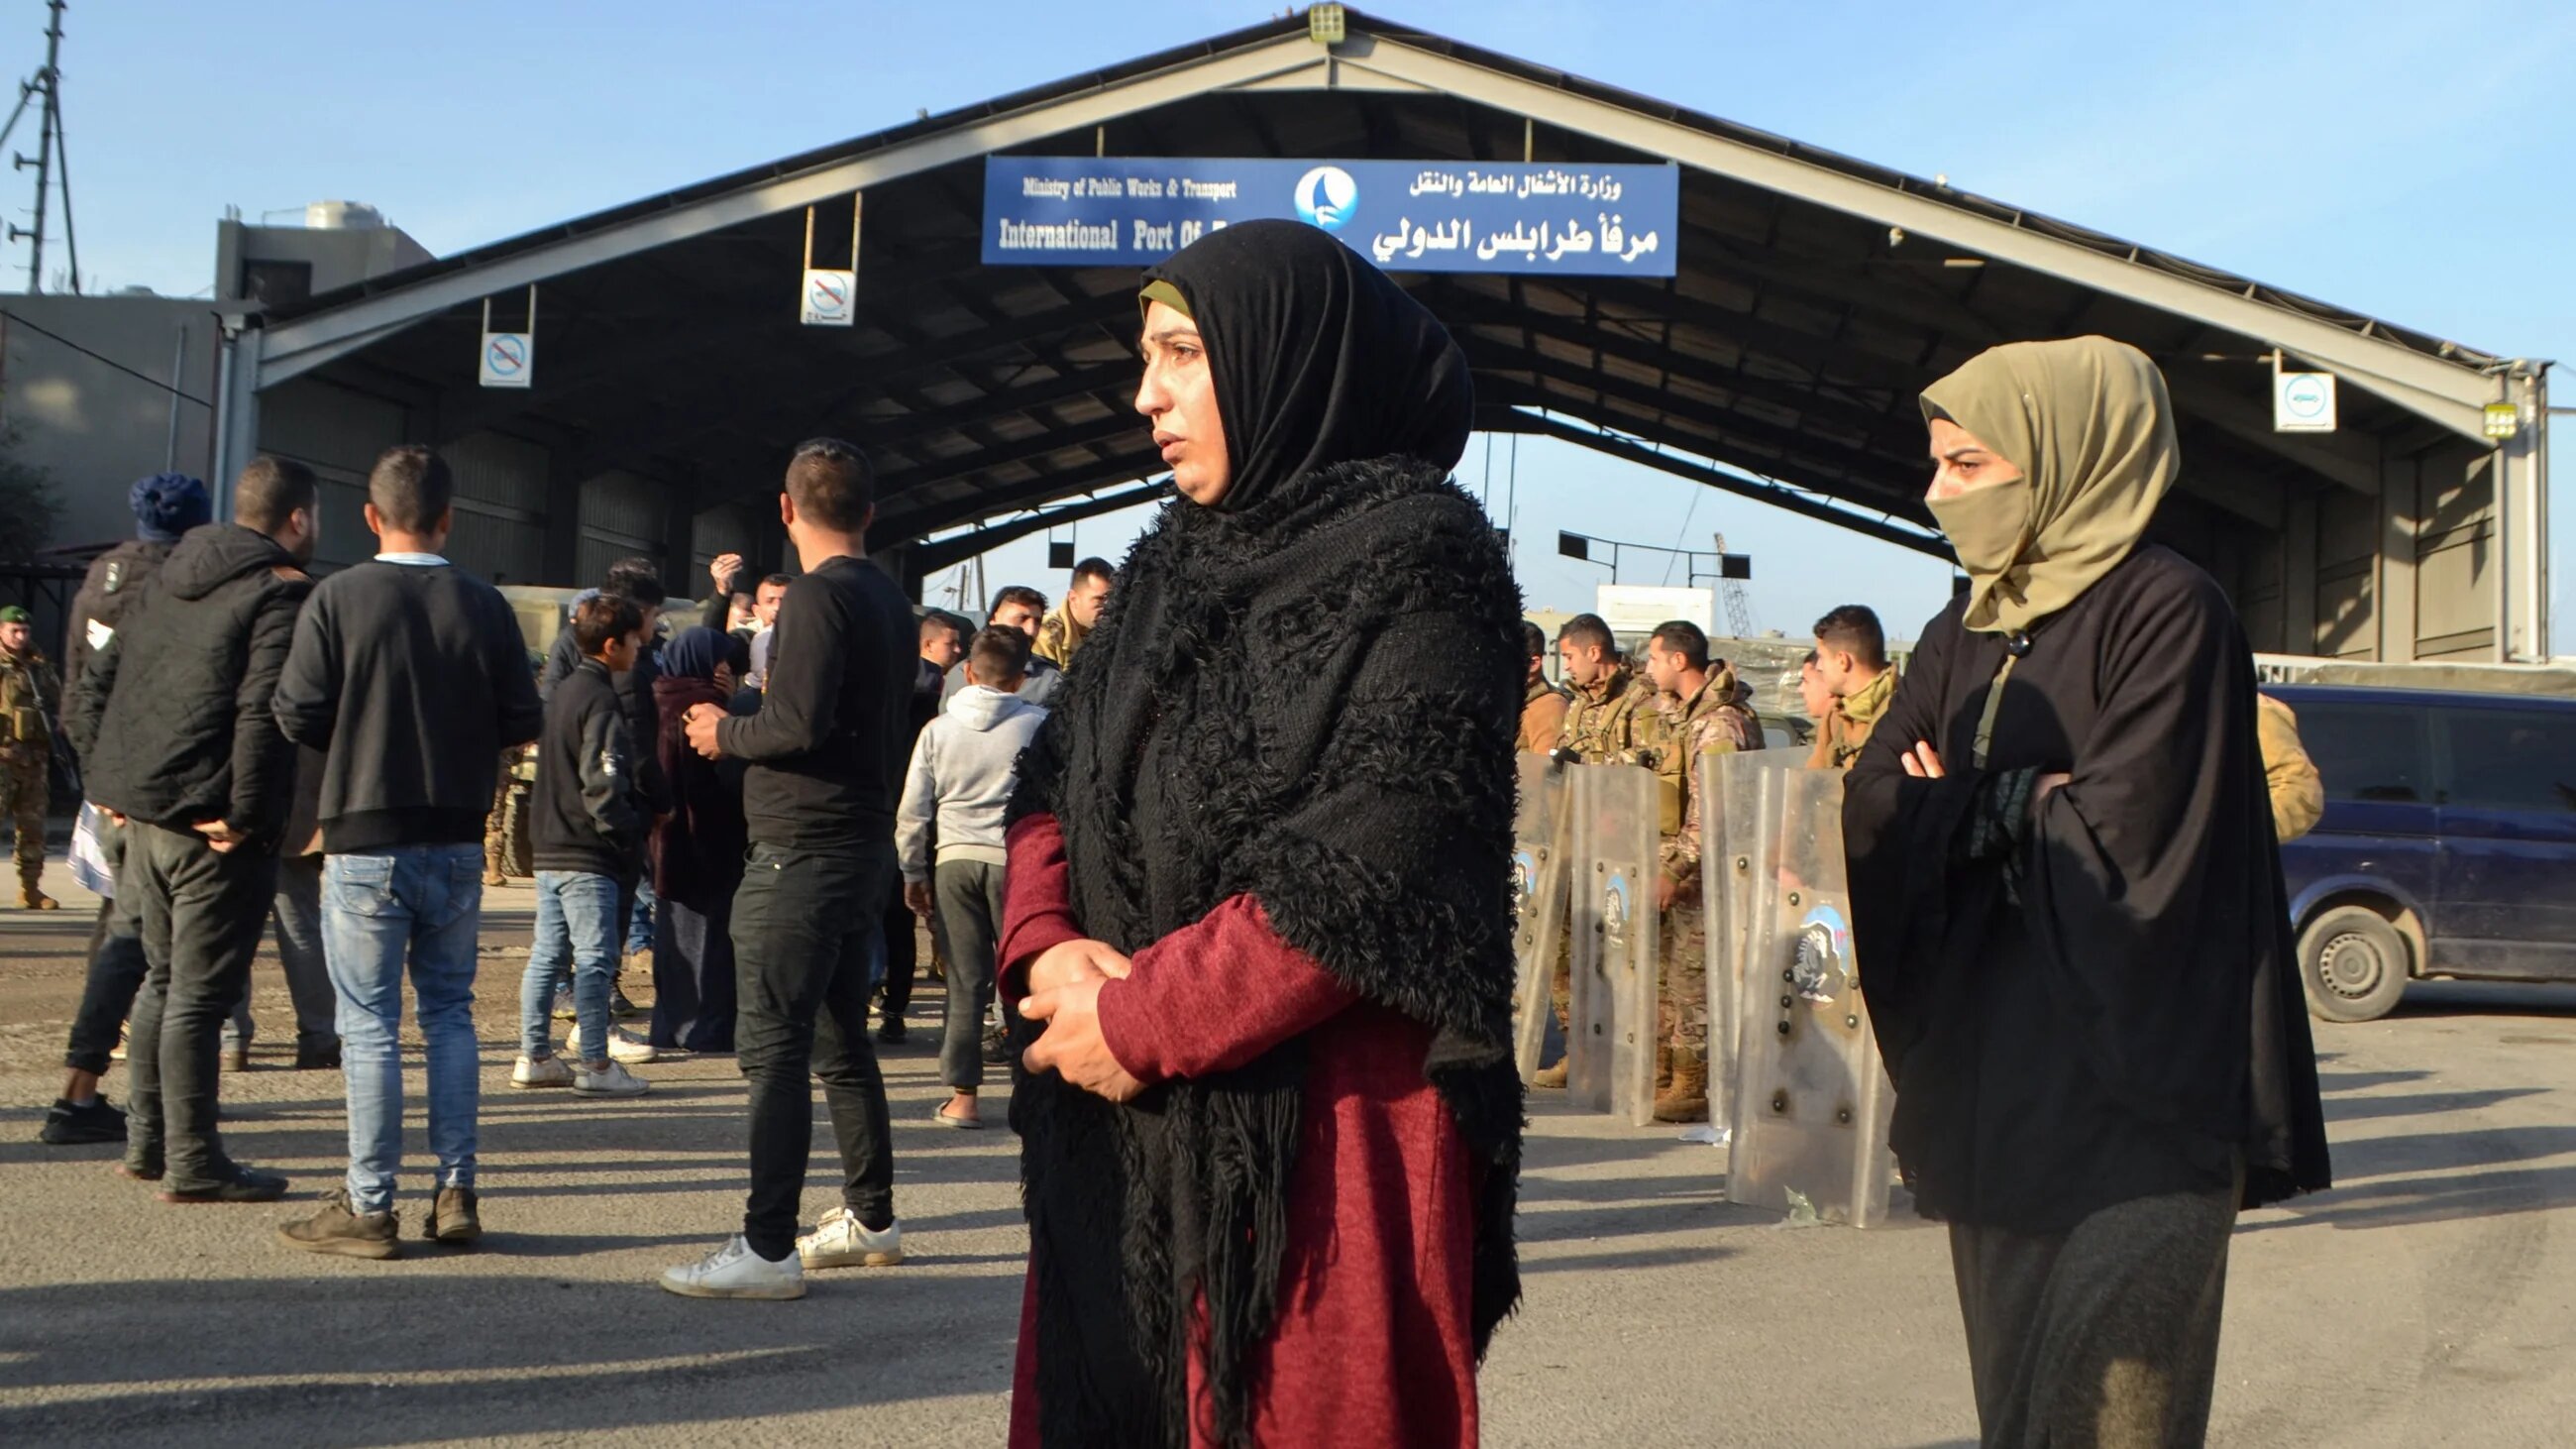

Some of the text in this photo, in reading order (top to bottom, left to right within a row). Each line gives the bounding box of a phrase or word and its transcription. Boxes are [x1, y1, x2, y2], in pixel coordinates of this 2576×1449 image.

[1022, 176, 1236, 202] Ministry of Public Works & Transport
[1409, 169, 1622, 202] وزارة الأشغال العامة والنقل
[999, 217, 1203, 251] International Port Of
[1371, 211, 1659, 263] مرفأ طرابلس الدولي
